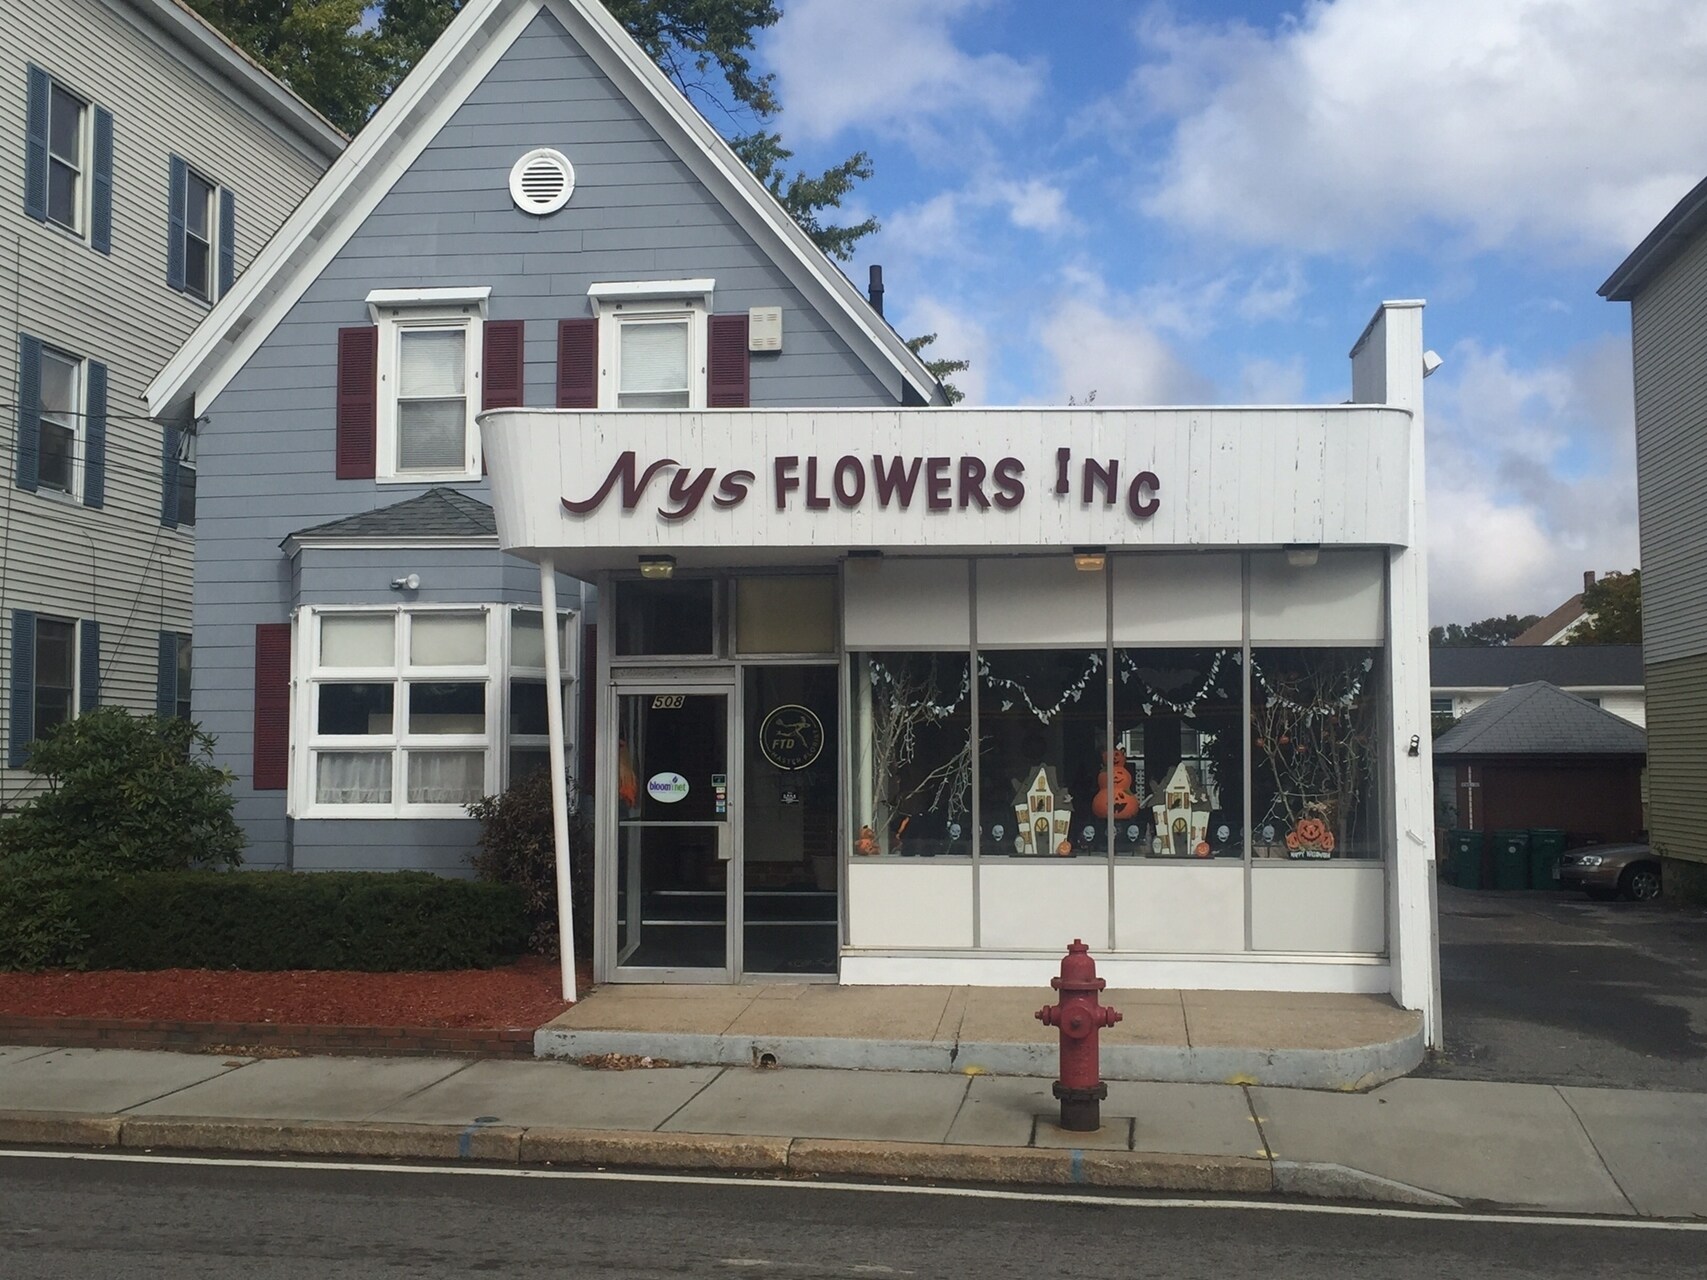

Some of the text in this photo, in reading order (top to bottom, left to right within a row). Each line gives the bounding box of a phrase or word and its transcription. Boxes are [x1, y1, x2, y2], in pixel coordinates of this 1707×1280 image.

[561, 448, 1161, 519] Nys FLOWERS INC
[654, 695, 684, 708] 508
[772, 738, 795, 750] FTD
